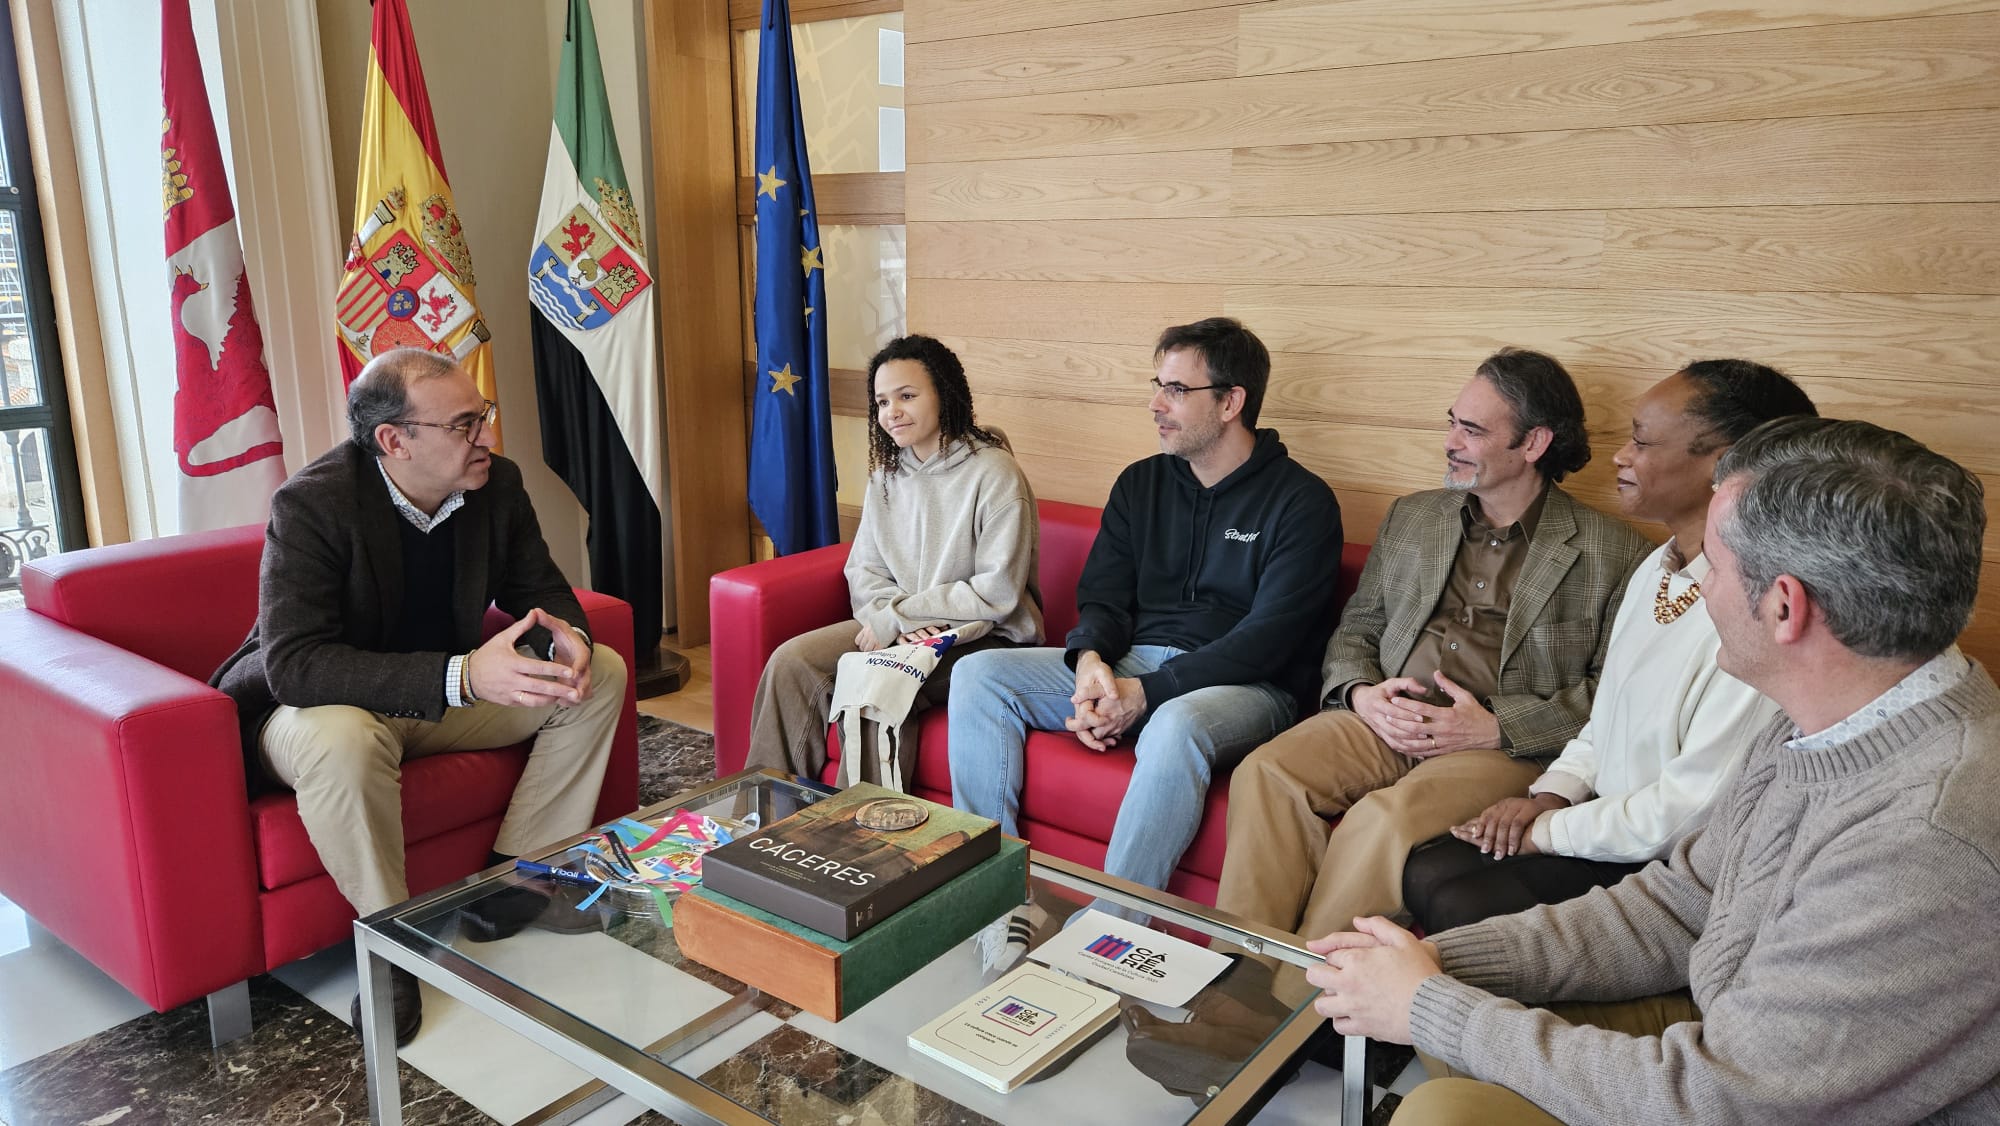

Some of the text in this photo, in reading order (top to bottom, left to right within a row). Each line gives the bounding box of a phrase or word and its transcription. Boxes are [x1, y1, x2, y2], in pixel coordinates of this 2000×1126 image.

[749, 837, 876, 886] CÁCERES
[1128, 953, 1160, 968] CE
[1135, 947, 1168, 962] CÁ
[1120, 958, 1167, 978] RES
